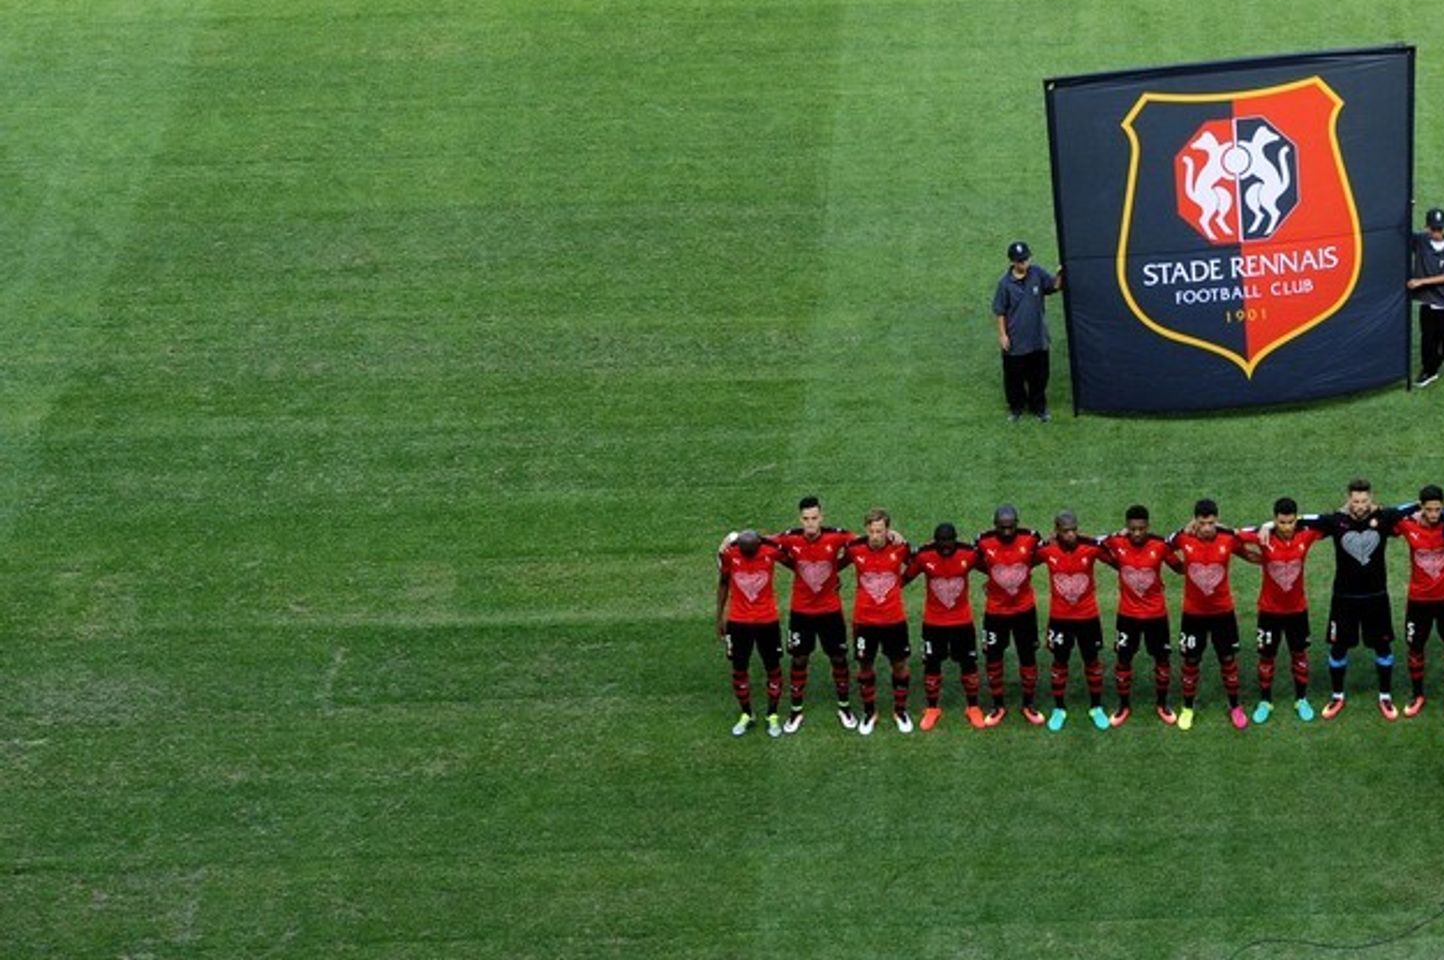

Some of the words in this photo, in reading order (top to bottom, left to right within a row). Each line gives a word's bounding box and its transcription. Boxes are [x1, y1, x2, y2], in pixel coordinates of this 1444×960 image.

[1143, 258, 1223, 286] STADE
[1230, 246, 1339, 279] RENNAIS
[1175, 285, 1262, 305] FOOTBALL
[1271, 279, 1314, 296] CLUB
[1226, 308, 1268, 323] 1901
